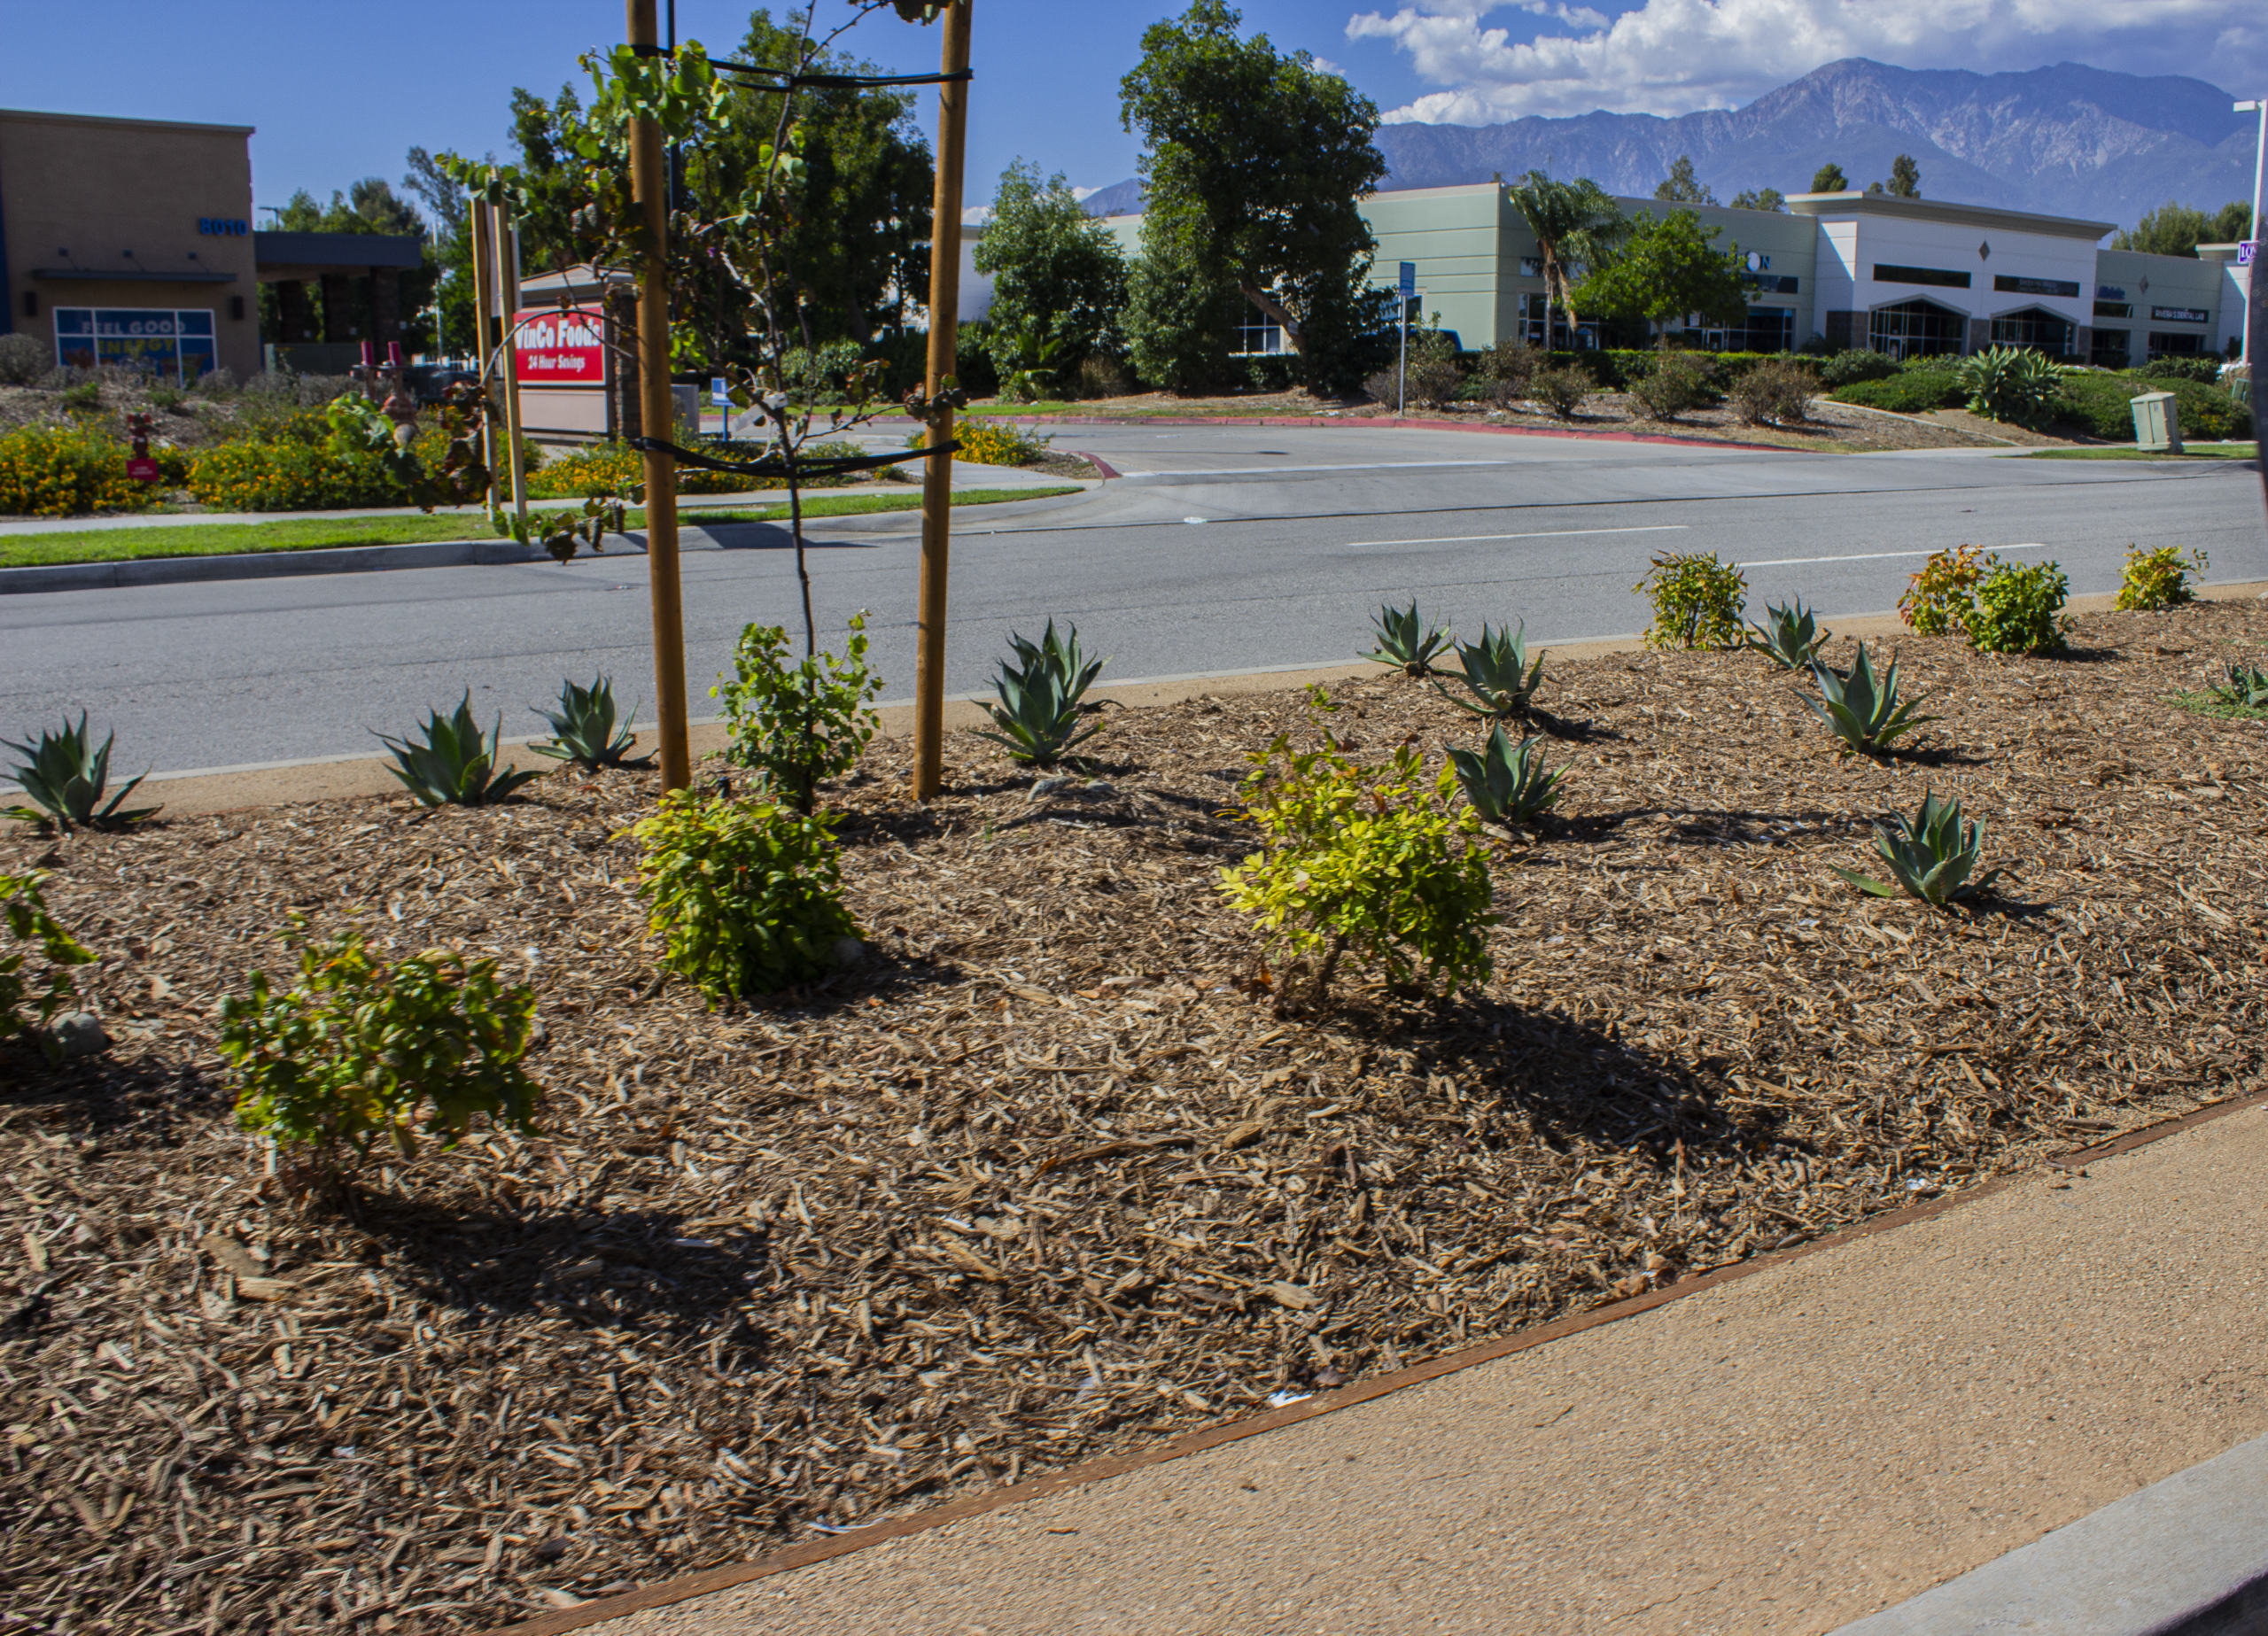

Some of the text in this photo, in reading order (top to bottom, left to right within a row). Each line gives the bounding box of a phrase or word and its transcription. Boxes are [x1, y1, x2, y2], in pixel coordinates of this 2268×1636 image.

[200, 217, 248, 236] 8010
[2195, 312, 2205, 321] LAB
[82, 321, 185, 335] FEEL GOOD
[557, 318, 601, 348] Foods
[98, 338, 175, 353] ENERGY
[528, 353, 586, 373] 24 Hour Savings
